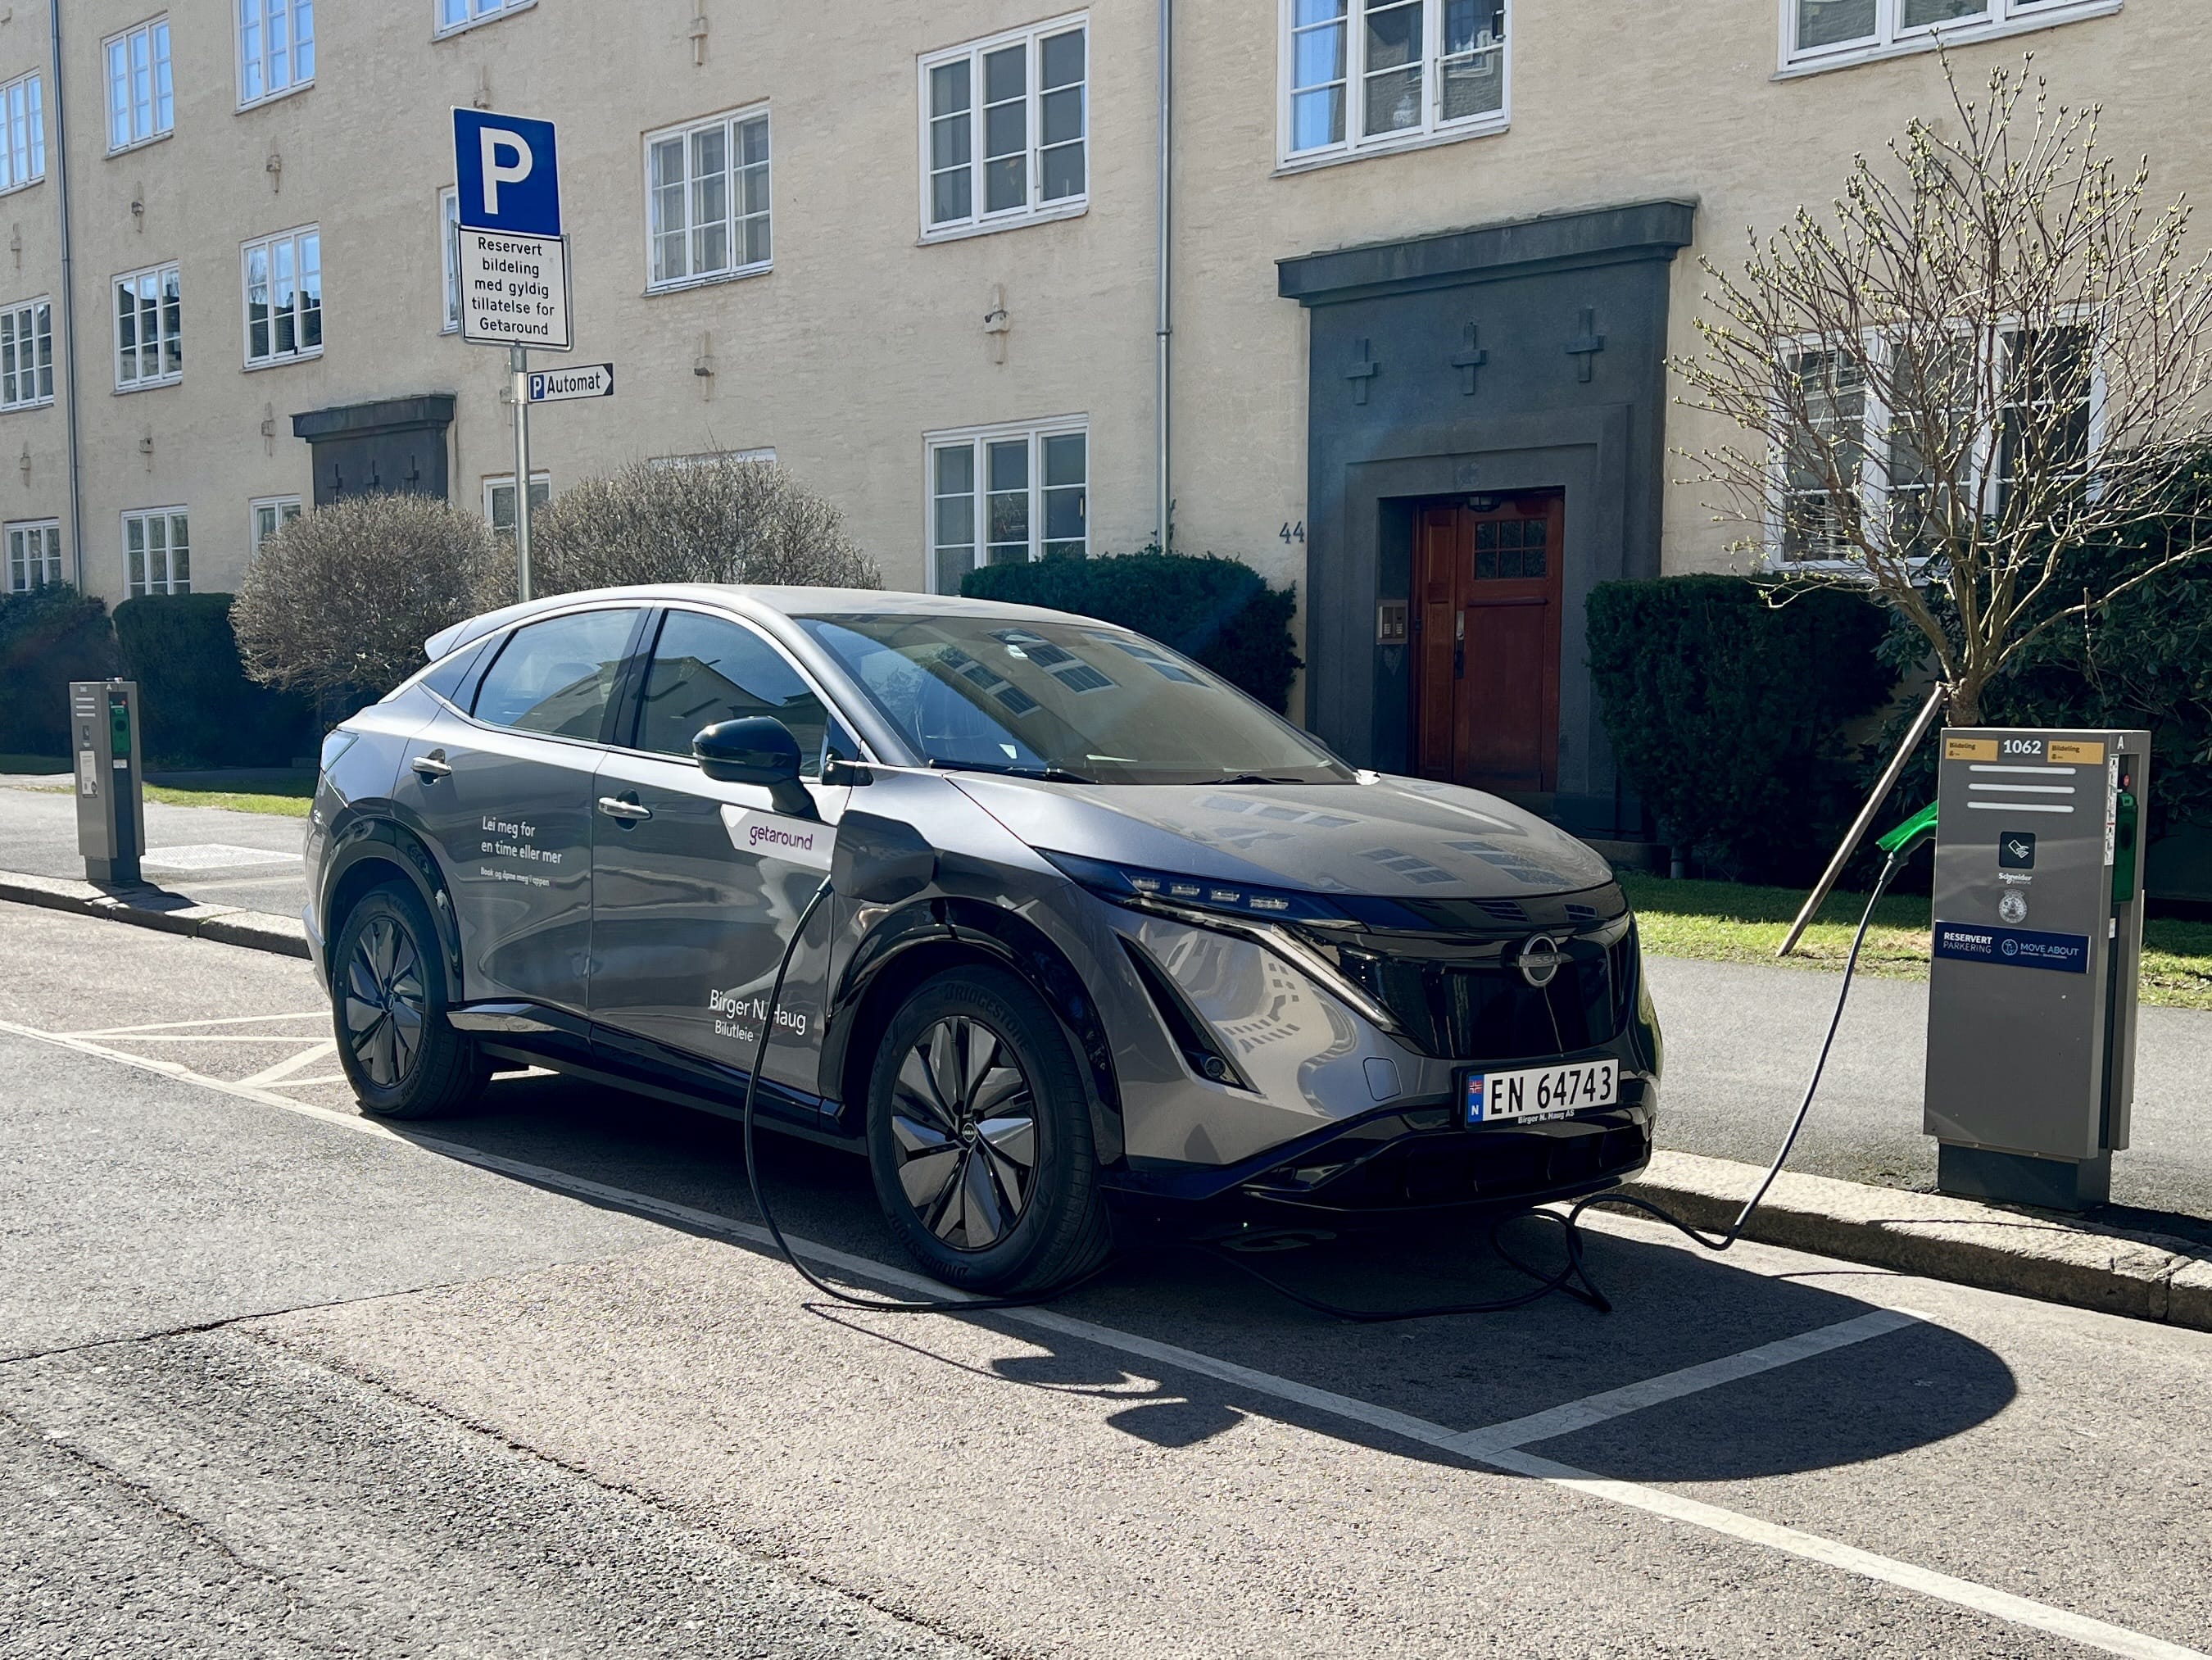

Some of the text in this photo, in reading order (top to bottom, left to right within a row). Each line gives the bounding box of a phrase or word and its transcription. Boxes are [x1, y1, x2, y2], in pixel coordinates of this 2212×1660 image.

[479, 126, 533, 215] P
[478, 237, 542, 256] Reservert
[482, 257, 540, 278] bildeling
[474, 278, 549, 298] med gyldig
[472, 297, 555, 316] tillatelse for
[479, 317, 548, 335] Getaround
[533, 372, 601, 397] P Automat
[1279, 520, 1304, 545] 44
[2003, 739, 2042, 755] 1062
[2117, 735, 2124, 750] A
[482, 816, 536, 839] Lei meg for
[749, 826, 814, 850] getaround
[481, 840, 562, 864] en time eller mer
[494, 871, 502, 881] og
[1942, 941, 1992, 954] PARKERING
[1943, 932, 1993, 945] RESERVERT
[2020, 942, 2047, 953] MOVE
[2047, 946, 2080, 956] ABOUT
[709, 989, 750, 1019] Birger
[714, 1019, 754, 1042] Bilutleie
[1490, 1066, 1611, 1115] EN 64743
[1471, 1104, 1479, 1116] N
[1517, 1115, 1539, 1125] Birger
[1565, 1109, 1575, 1118] AS
